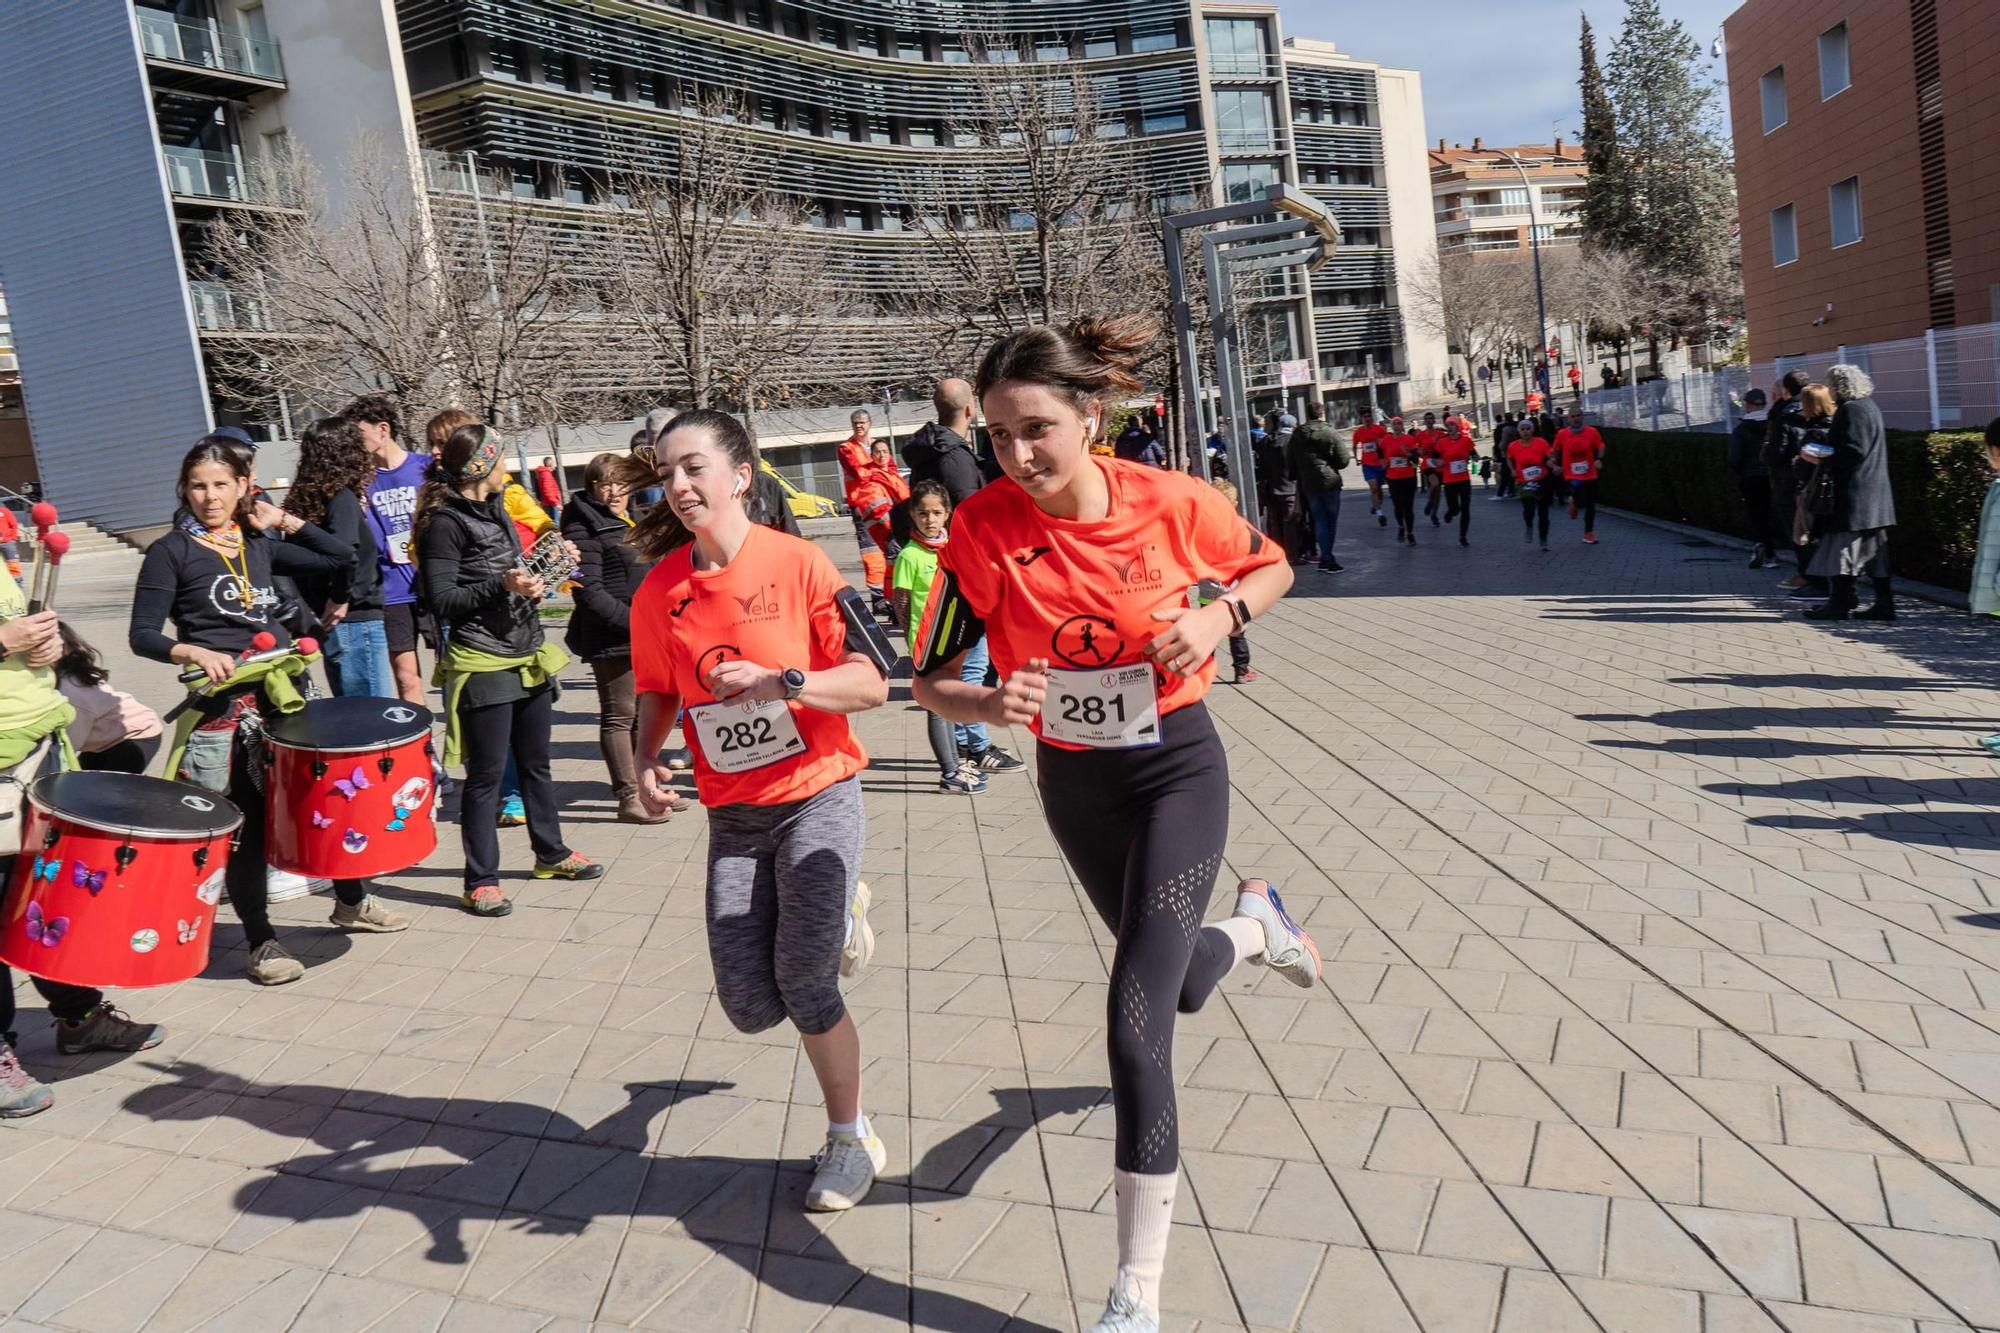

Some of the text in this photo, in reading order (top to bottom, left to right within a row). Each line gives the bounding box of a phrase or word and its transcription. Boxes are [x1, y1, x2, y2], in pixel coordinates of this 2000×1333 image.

[372, 486, 416, 505] CURSA
[1060, 693, 1125, 725] 281
[715, 717, 777, 753] 282
